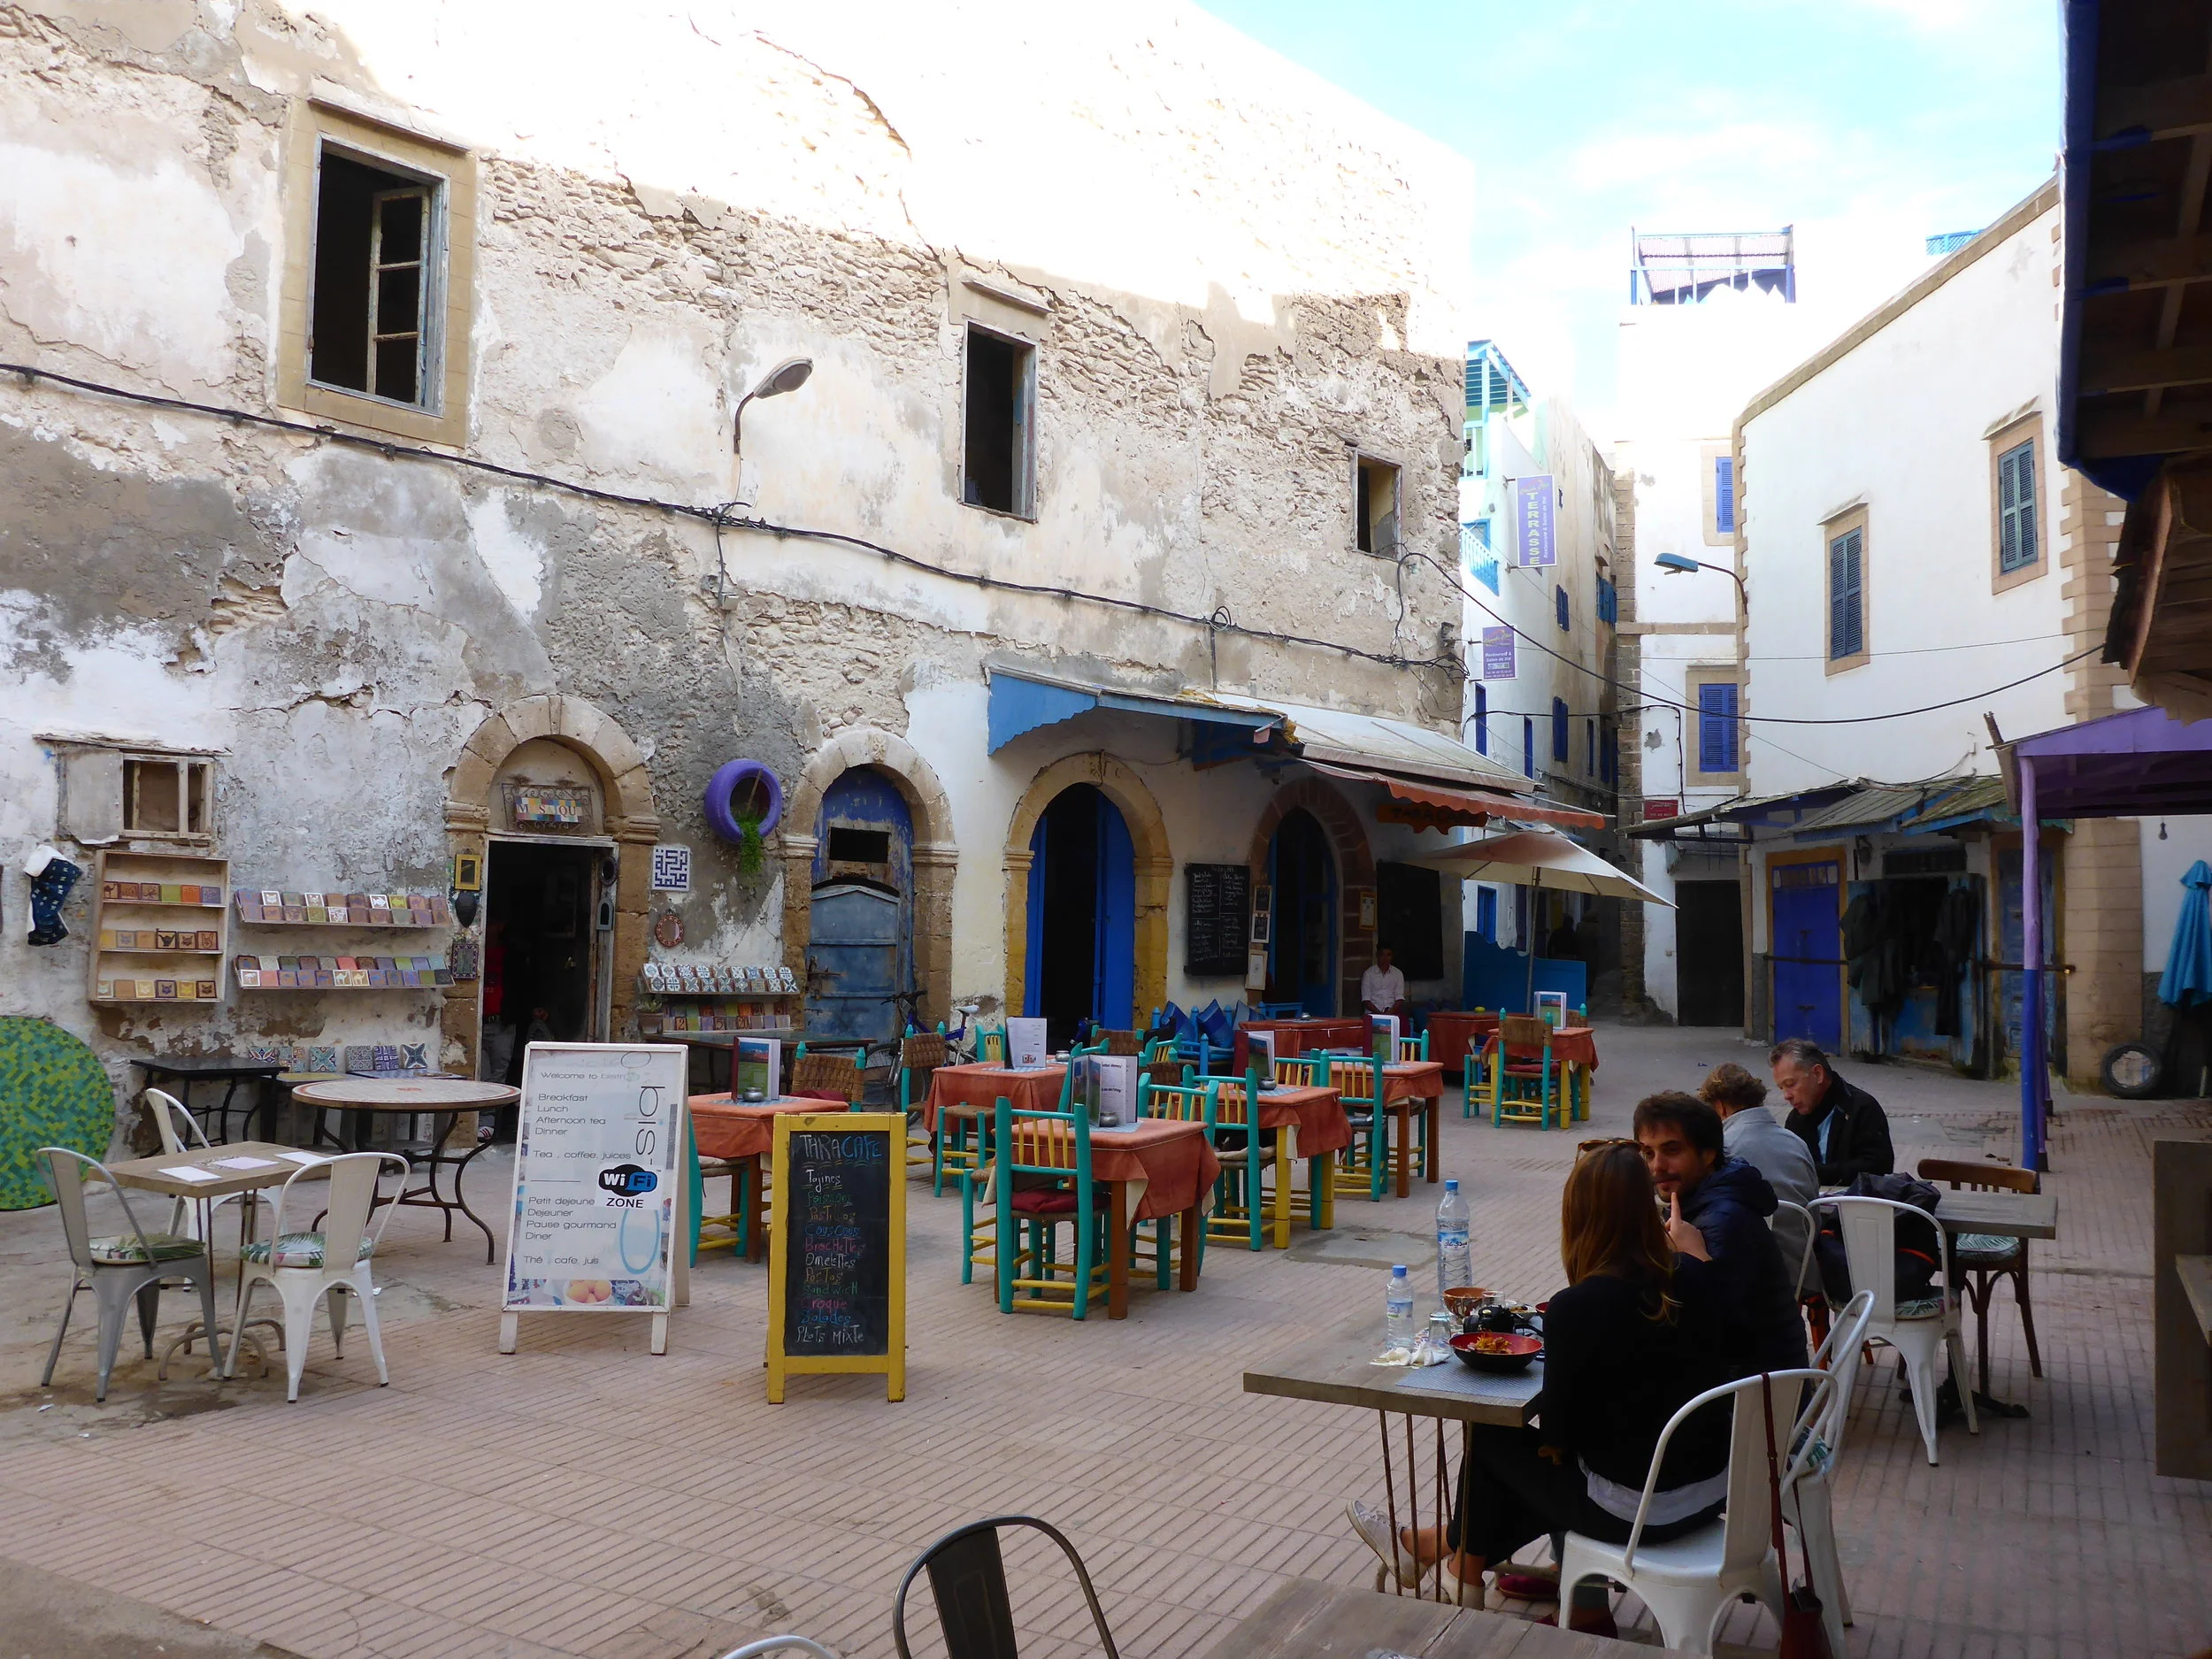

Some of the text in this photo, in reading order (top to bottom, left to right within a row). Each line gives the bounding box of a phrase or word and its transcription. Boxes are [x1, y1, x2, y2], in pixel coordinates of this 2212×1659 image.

[1527, 492, 1540, 565] TERRASSE
[538, 1093, 588, 1102] Breakfast
[806, 1169, 841, 1193] Tajines
[606, 1197, 644, 1209] ZONE
[527, 1208, 573, 1217] Dejeuner
[583, 1256, 599, 1265] jus
